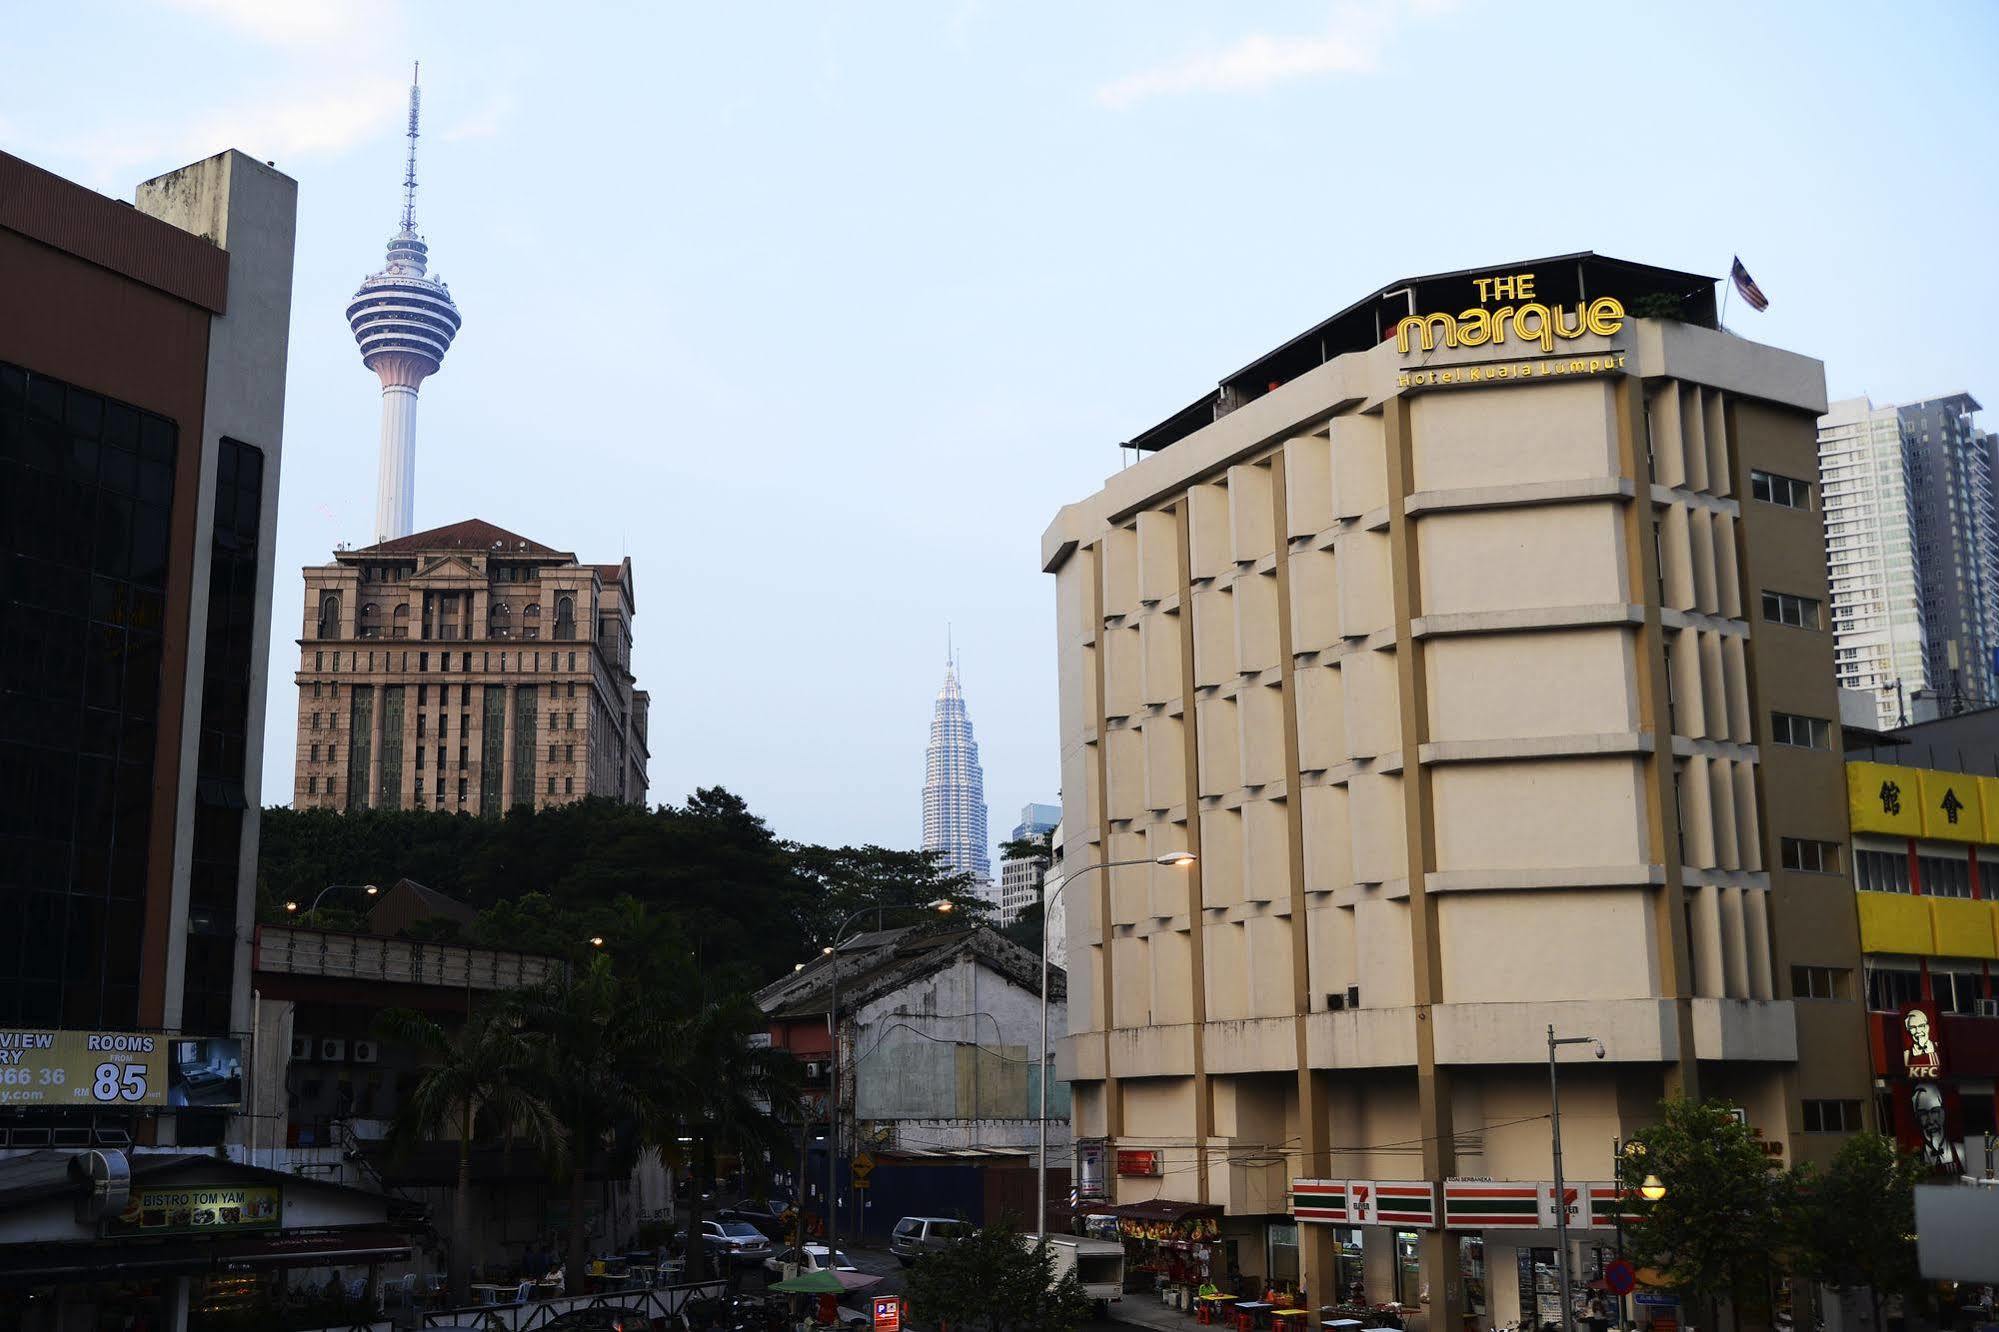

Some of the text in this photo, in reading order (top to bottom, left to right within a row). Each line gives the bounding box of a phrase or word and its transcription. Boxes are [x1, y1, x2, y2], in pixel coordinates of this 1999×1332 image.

[1473, 274, 1536, 302] THE
[1396, 296, 1625, 353] marque
[1399, 356, 1625, 387] Hotel Kuala Lumpur
[87, 1034, 155, 1053] ROOMS
[110, 1055, 133, 1063] FROM
[40, 1068, 65, 1085] 36
[73, 1088, 89, 1097] RM
[93, 1062, 147, 1101] 85
[1909, 1066, 1938, 1078] KFC
[144, 1192, 245, 1207] BISTRO TOM YAM
[1353, 1186, 1369, 1220] 7
